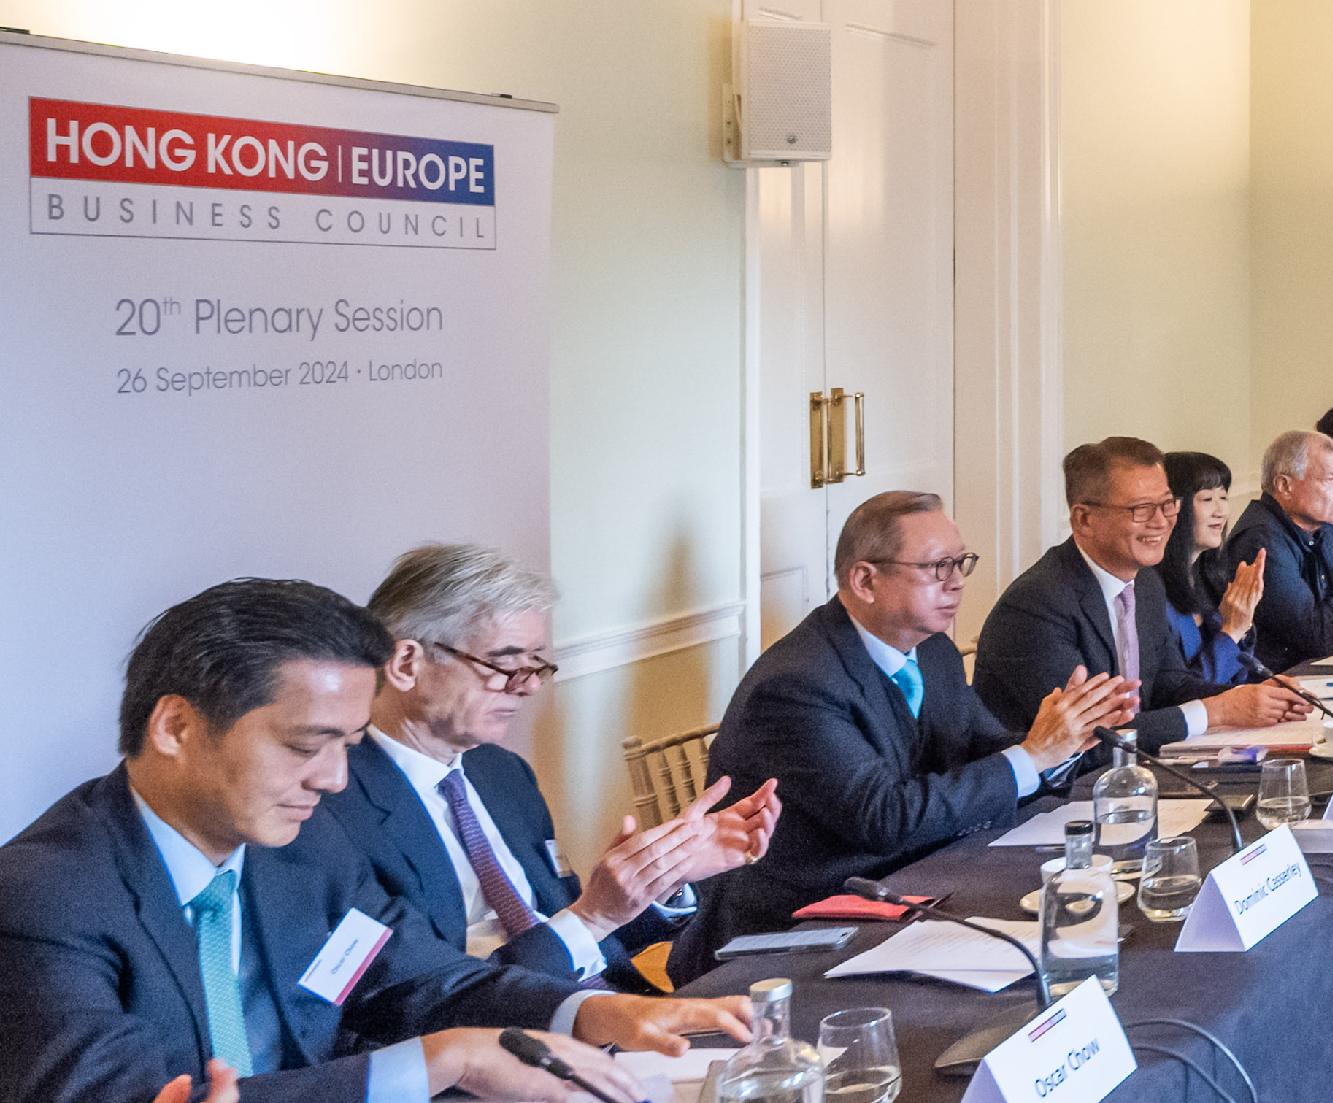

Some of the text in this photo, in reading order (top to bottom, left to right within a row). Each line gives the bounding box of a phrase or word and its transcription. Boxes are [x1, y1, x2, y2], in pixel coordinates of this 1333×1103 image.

[46, 118, 486, 193] HONG KONG EUROPE
[48, 194, 486, 239] BUSINESS COUNCIL
[115, 297, 444, 341] 20th Plenary Session
[116, 360, 444, 396] 26 September 2024 London
[1033, 1037, 1101, 1098] Oscar Chow
